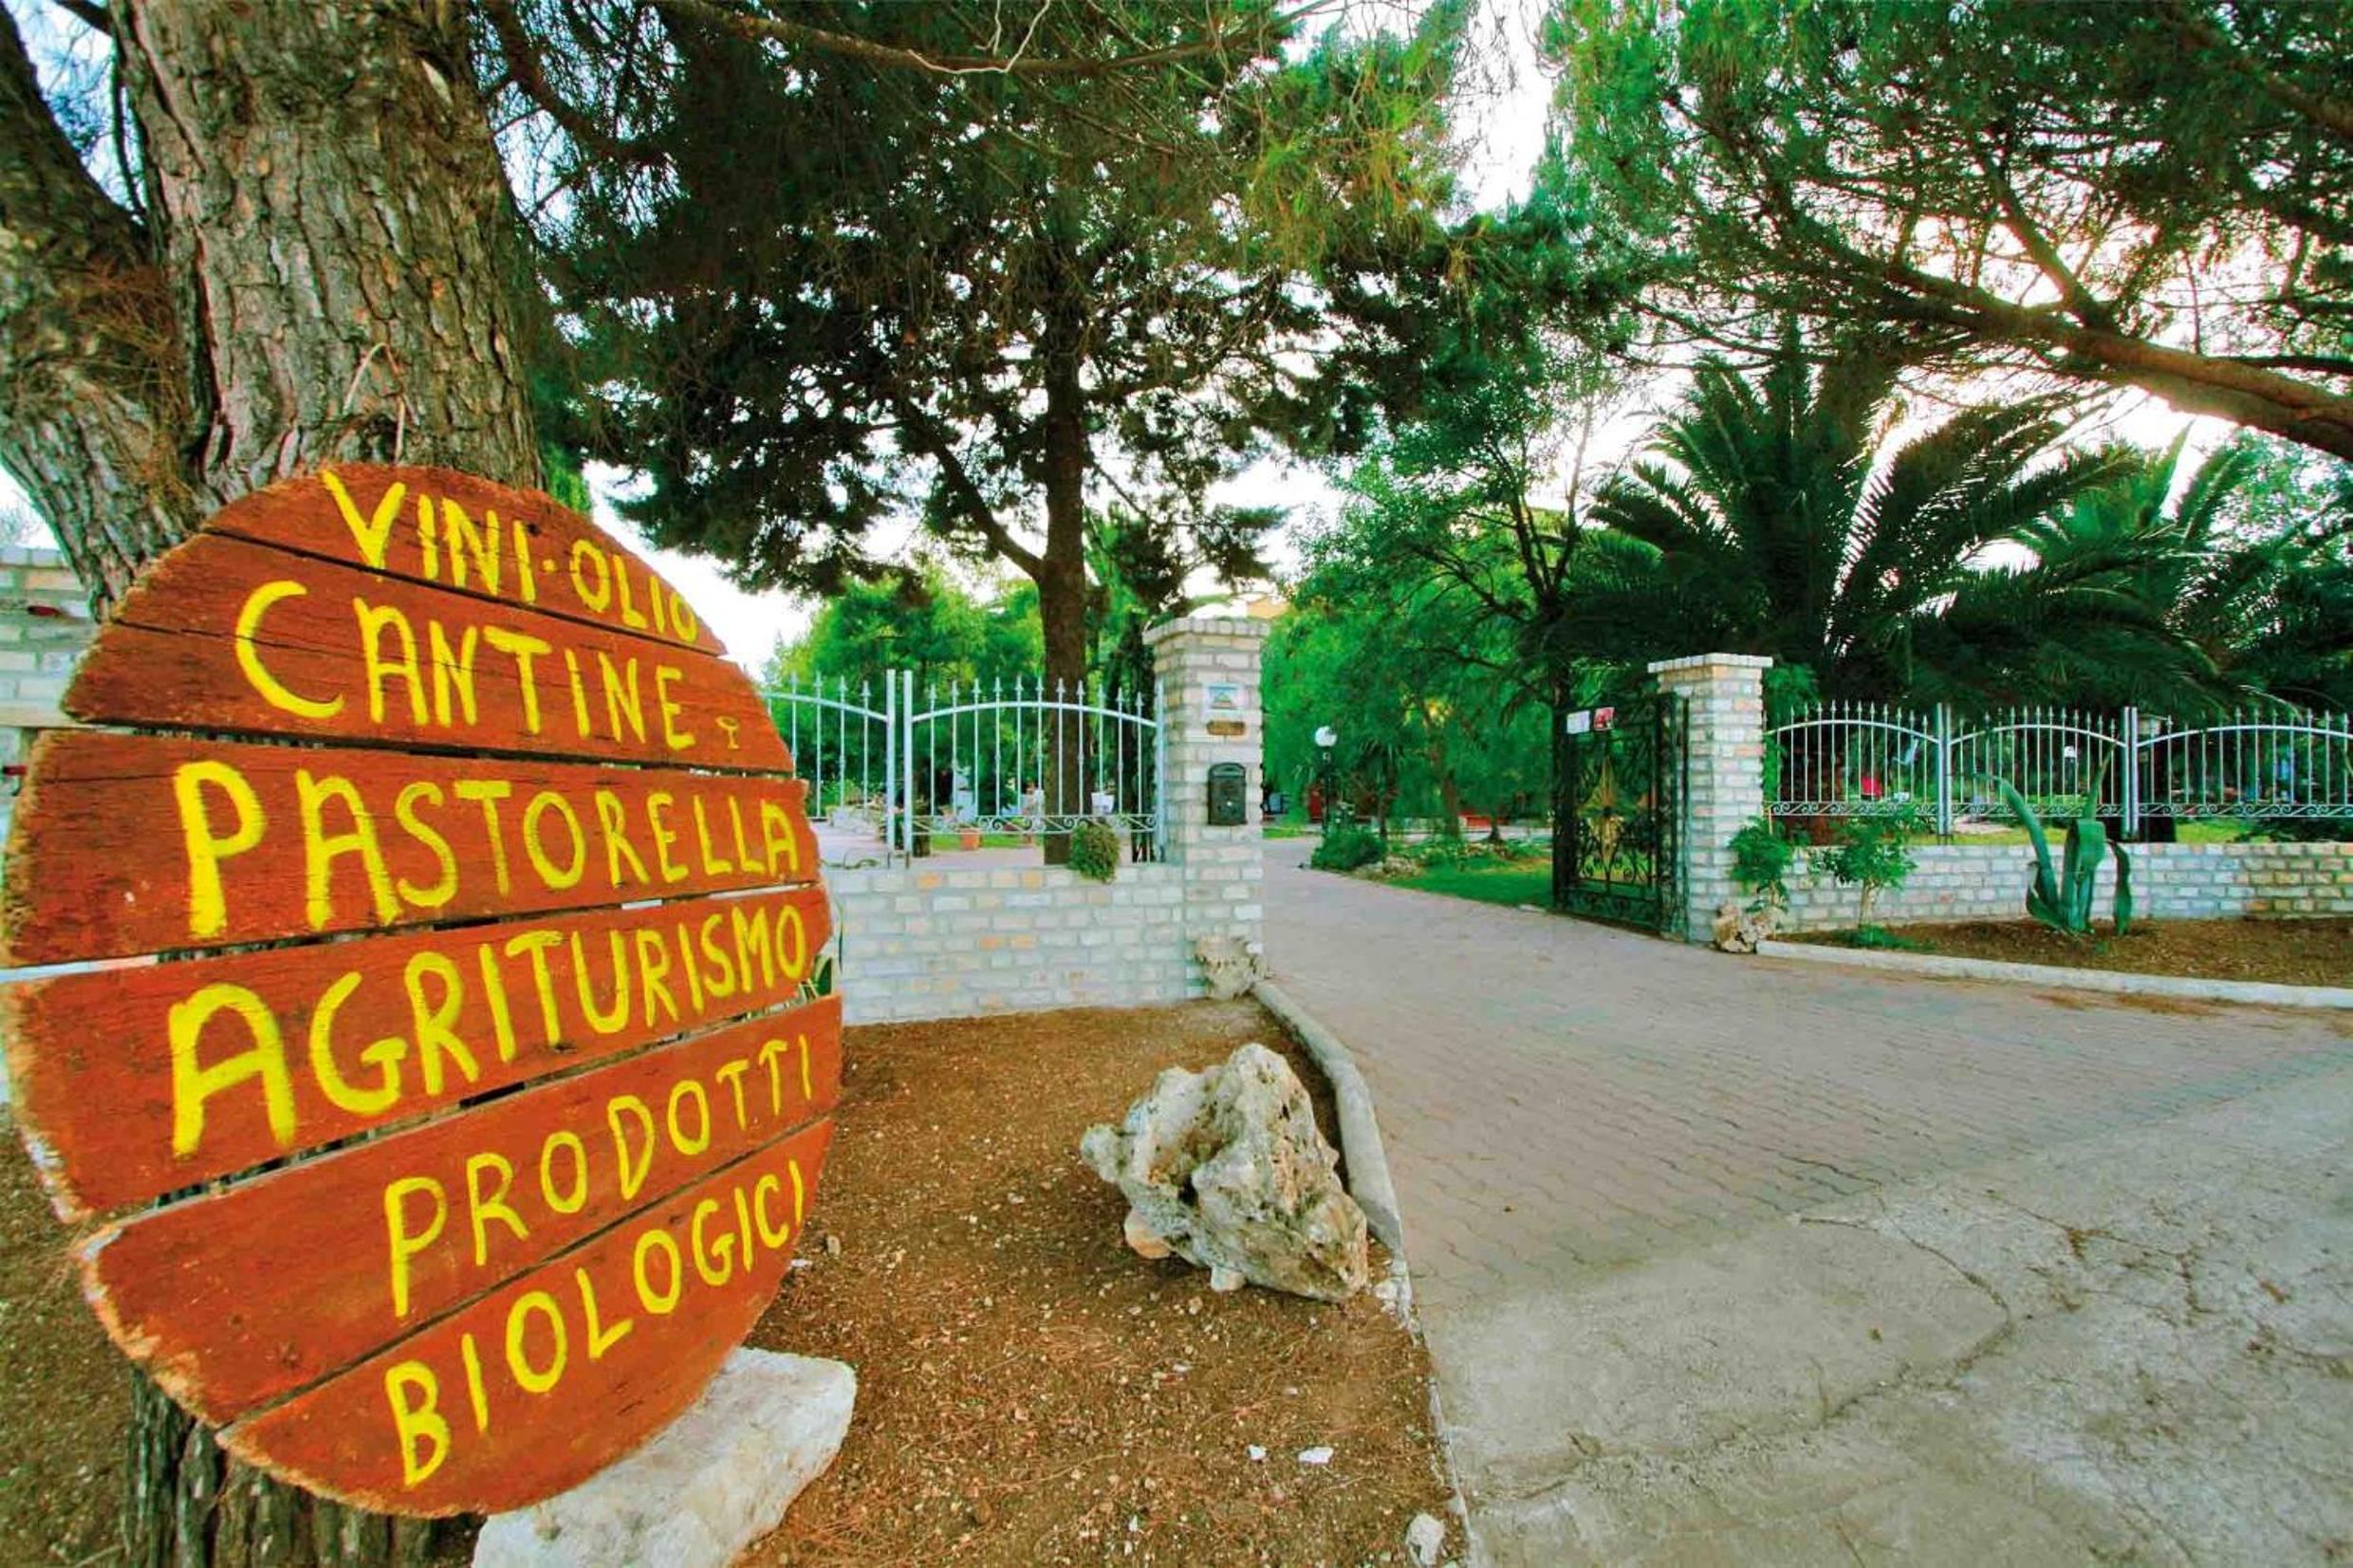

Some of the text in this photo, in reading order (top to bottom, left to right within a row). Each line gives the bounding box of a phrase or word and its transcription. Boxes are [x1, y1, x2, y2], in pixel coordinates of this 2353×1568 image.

[235, 580, 696, 752] CANTINE
[174, 759, 801, 940] PASTORELLA
[168, 905, 808, 1156] AGRITURISMO
[383, 1034, 813, 1318] PRODOTTI
[384, 1158, 806, 1488] BIOLOGICI
